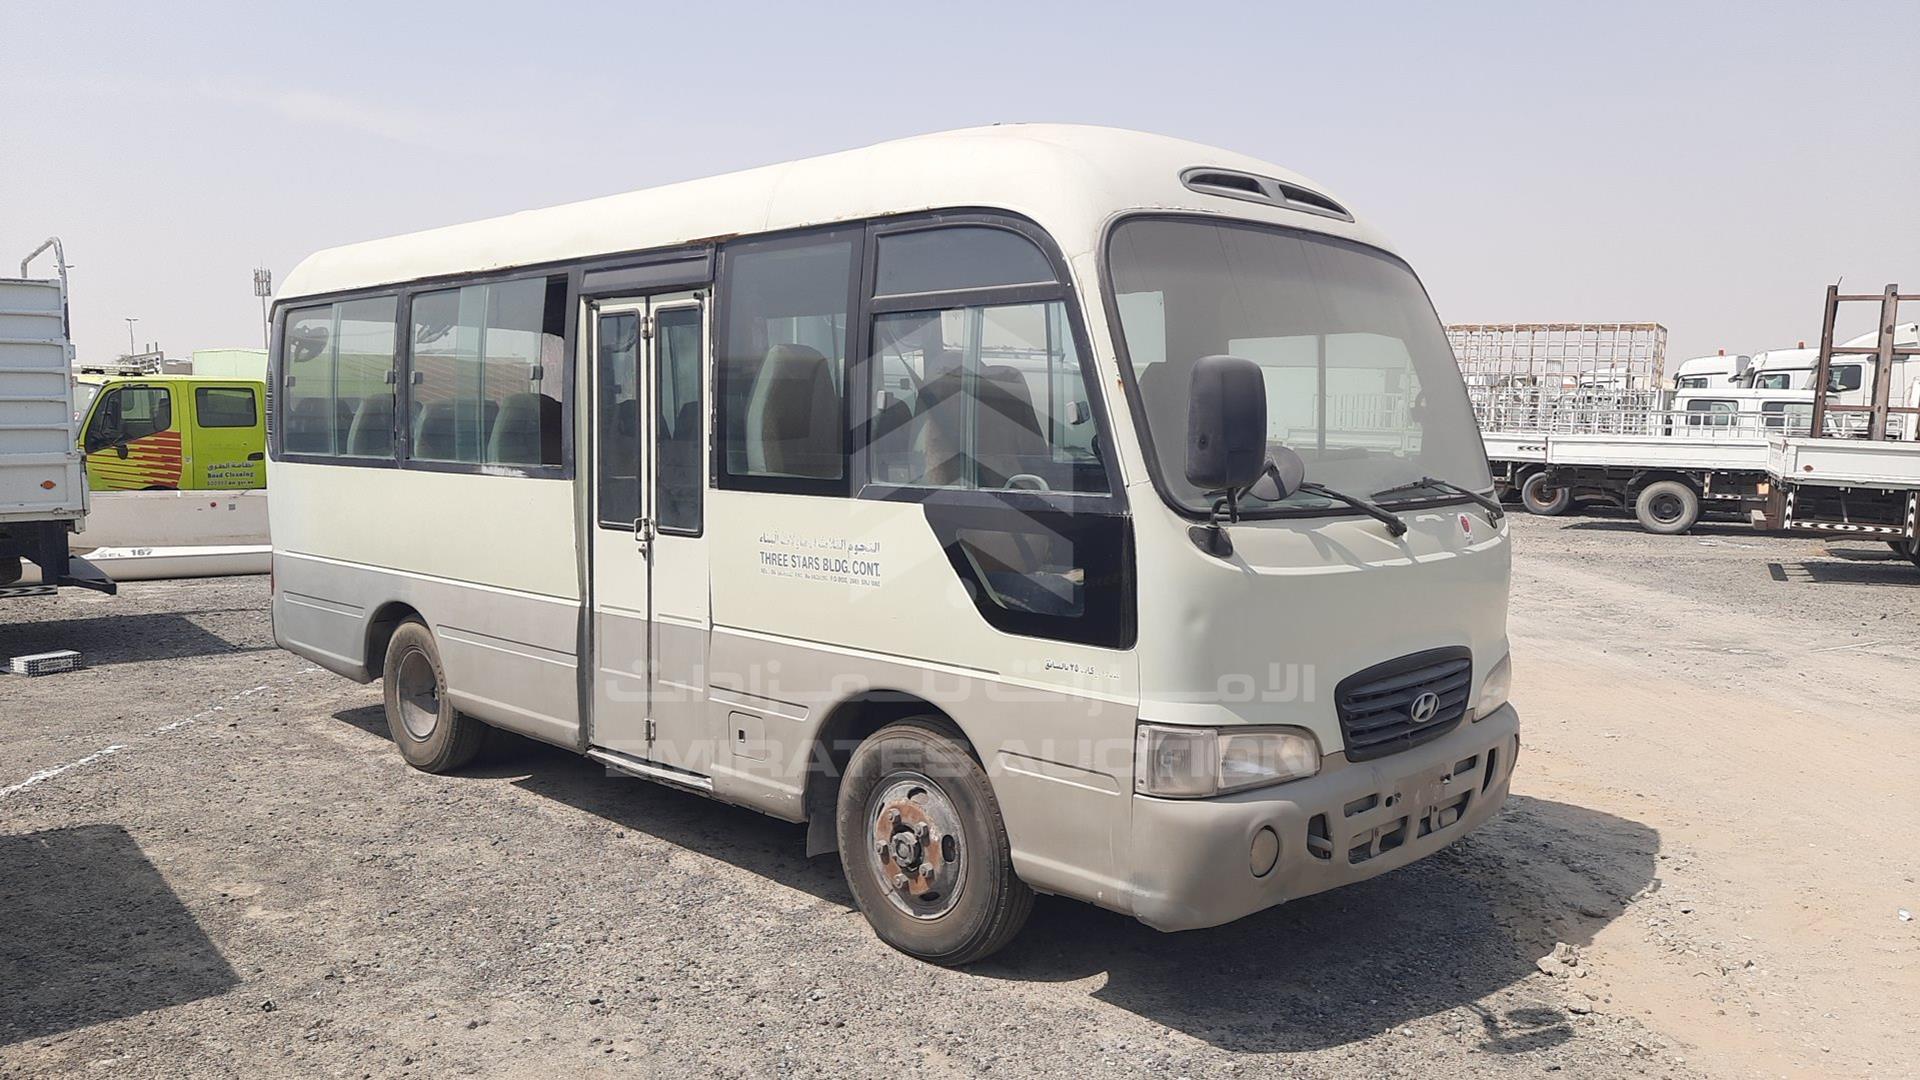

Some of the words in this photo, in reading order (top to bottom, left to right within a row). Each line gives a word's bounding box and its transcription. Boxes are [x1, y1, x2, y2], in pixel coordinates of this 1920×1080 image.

[760, 551, 789, 567] THREE
[791, 554, 820, 571] STARS
[823, 558, 851, 574] BLDG.
[852, 560, 880, 577] CONT.
